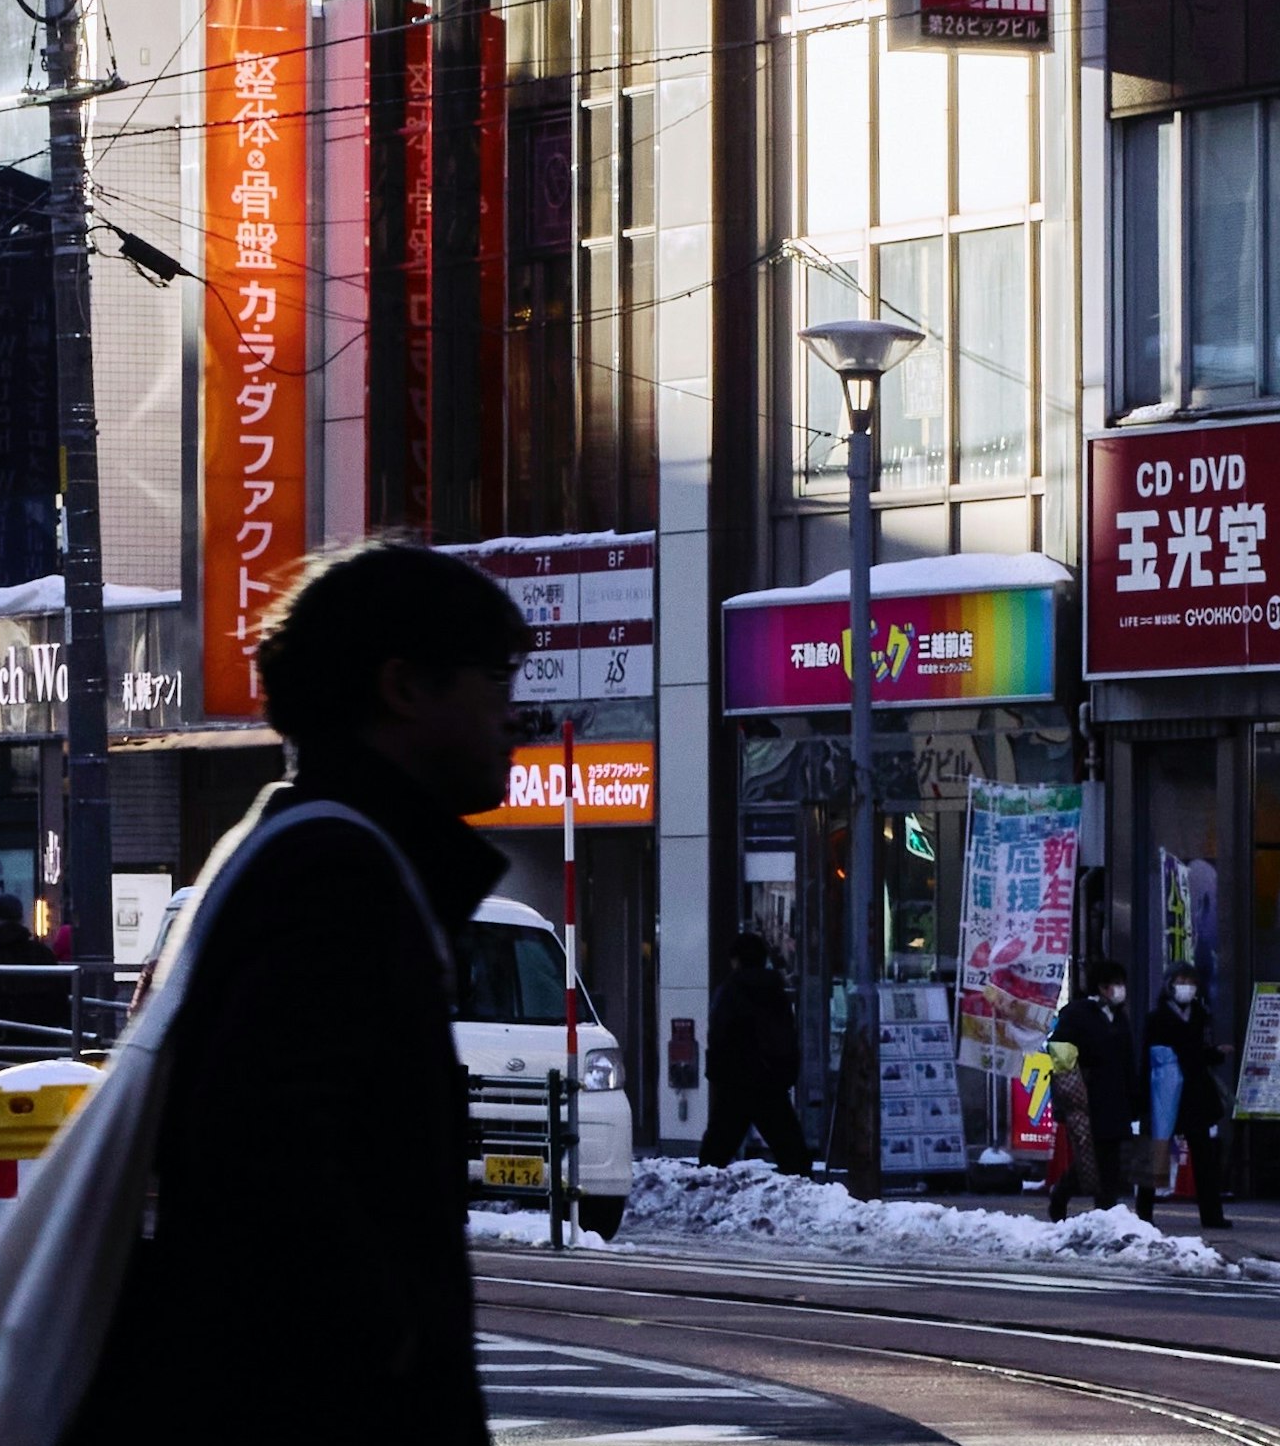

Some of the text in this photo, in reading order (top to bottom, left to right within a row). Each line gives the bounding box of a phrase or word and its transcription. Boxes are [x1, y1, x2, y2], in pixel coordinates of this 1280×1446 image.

[535, 550, 625, 573] 7F 8F
[1116, 502, 1267, 593] 玉光堂
[1120, 616, 1139, 628] LIFE
[1154, 614, 1181, 626] MUSIC
[1184, 605, 1264, 627] GYOKKODO
[535, 627, 625, 648] 3F 4F
[790, 641, 841, 669] 不動産の
[917, 630, 974, 659] 三越前店
[587, 778, 650, 809] factory
[1032, 828, 1076, 954] 新生活
